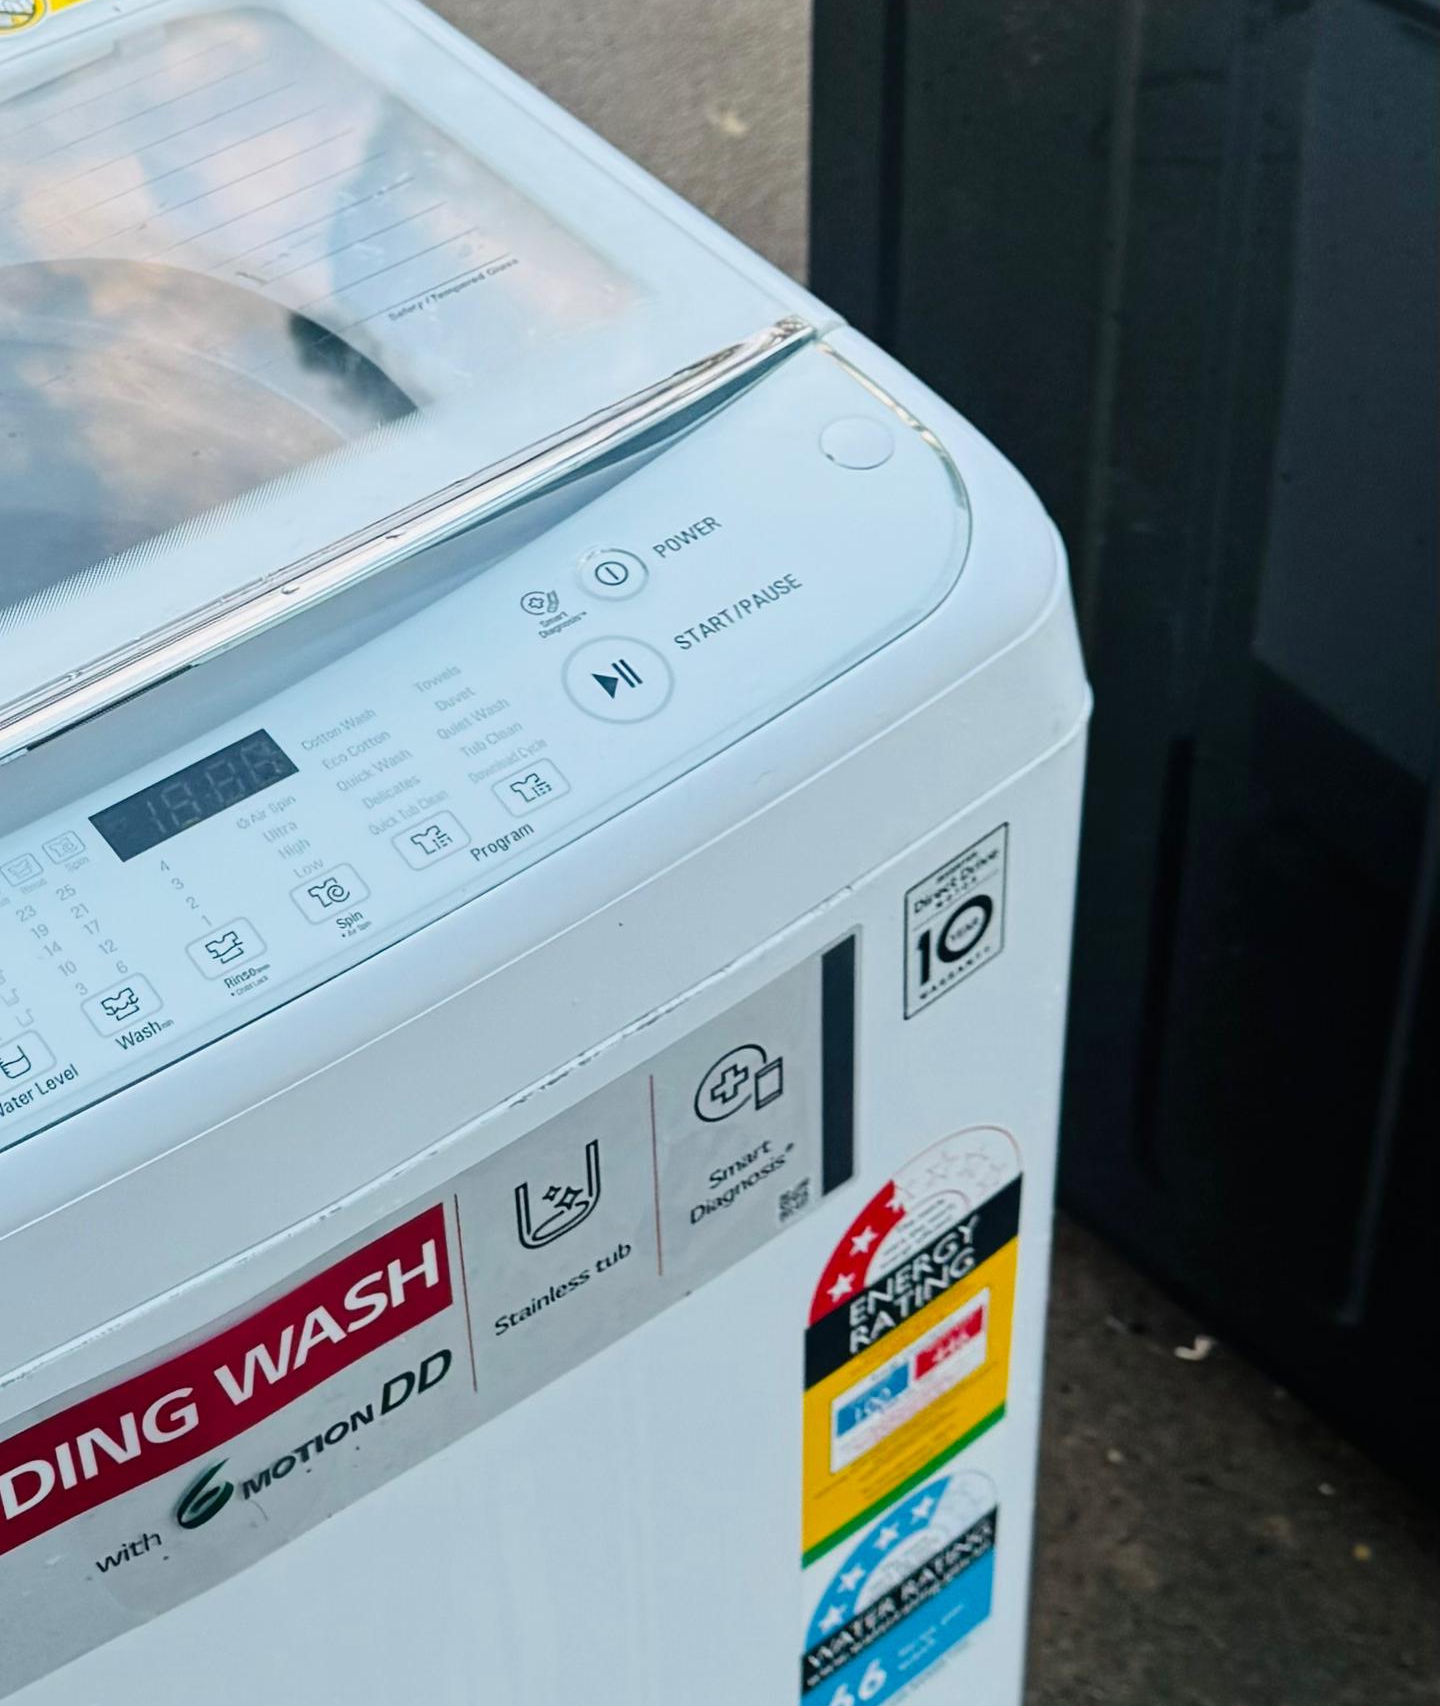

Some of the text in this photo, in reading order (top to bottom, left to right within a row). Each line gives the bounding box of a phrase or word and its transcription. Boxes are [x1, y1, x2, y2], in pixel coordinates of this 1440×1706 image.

[652, 516, 723, 559] POWER
[673, 573, 803, 651] START/PAUSE
[413, 664, 462, 694] Towels
[434, 686, 476, 712] Duvet
[301, 707, 378, 752] Cotton Wash
[436, 698, 511, 741] Quiet Wash
[321, 730, 392, 771] Eco Cotton
[459, 721, 524, 760] Tub Clean
[336, 747, 413, 793] Quick Wash
[361, 774, 422, 810] Delicates
[262, 821, 298, 843] Ultra
[278, 838, 311, 860] High
[469, 822, 535, 863] Program
[159, 860, 170, 873] 4
[171, 877, 185, 891] 3
[293, 858, 324, 878] Low
[16, 885, 77, 923] 23 25
[30, 903, 90, 940] 19 21
[186, 895, 200, 910] 2
[201, 914, 213, 927] 1
[335, 910, 365, 930] Spin
[43, 920, 101, 958] 14 17
[58, 939, 118, 977] 10 12
[917, 894, 994, 987] 10
[75, 960, 129, 995] 3 6
[114, 1021, 162, 1050] Wash
[34, 1063, 80, 1096] Level
[709, 1140, 772, 1189] Smart
[849, 1212, 980, 1327] ENERGY
[494, 1242, 632, 1336] Stainless tub
[849, 1247, 976, 1354] RATING
[214, 1239, 440, 1406] WASH
[95, 1532, 162, 1574] with
[241, 1403, 375, 1500] MOTION
